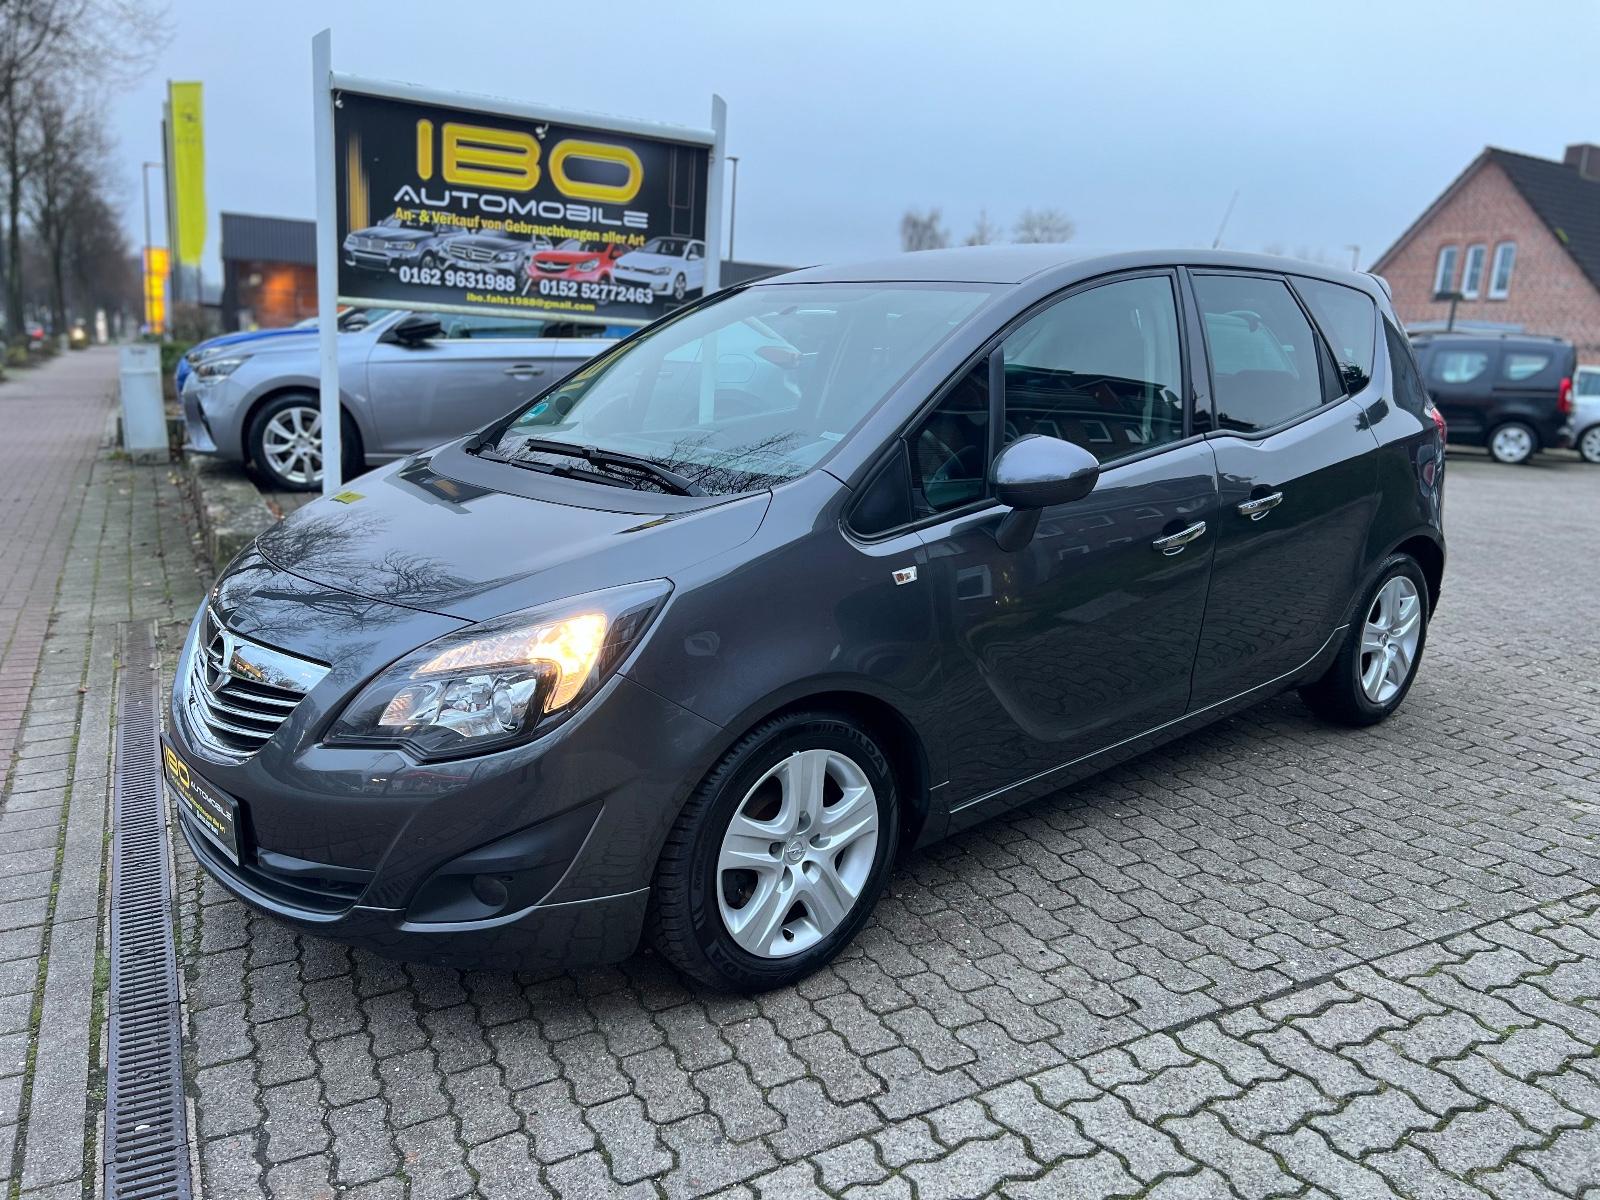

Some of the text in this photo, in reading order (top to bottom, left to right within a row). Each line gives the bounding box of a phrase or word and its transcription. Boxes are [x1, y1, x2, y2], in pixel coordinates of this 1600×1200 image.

[417, 118, 644, 204] IBO
[394, 185, 649, 229] AUTOMOBILE
[395, 207, 646, 247] An- & Verkauf von Gebrauchtwagen aller Art
[399, 266, 442, 286] 0162
[444, 269, 517, 292] 9631988
[540, 280, 578, 298] 0152
[580, 282, 654, 305] 52772463
